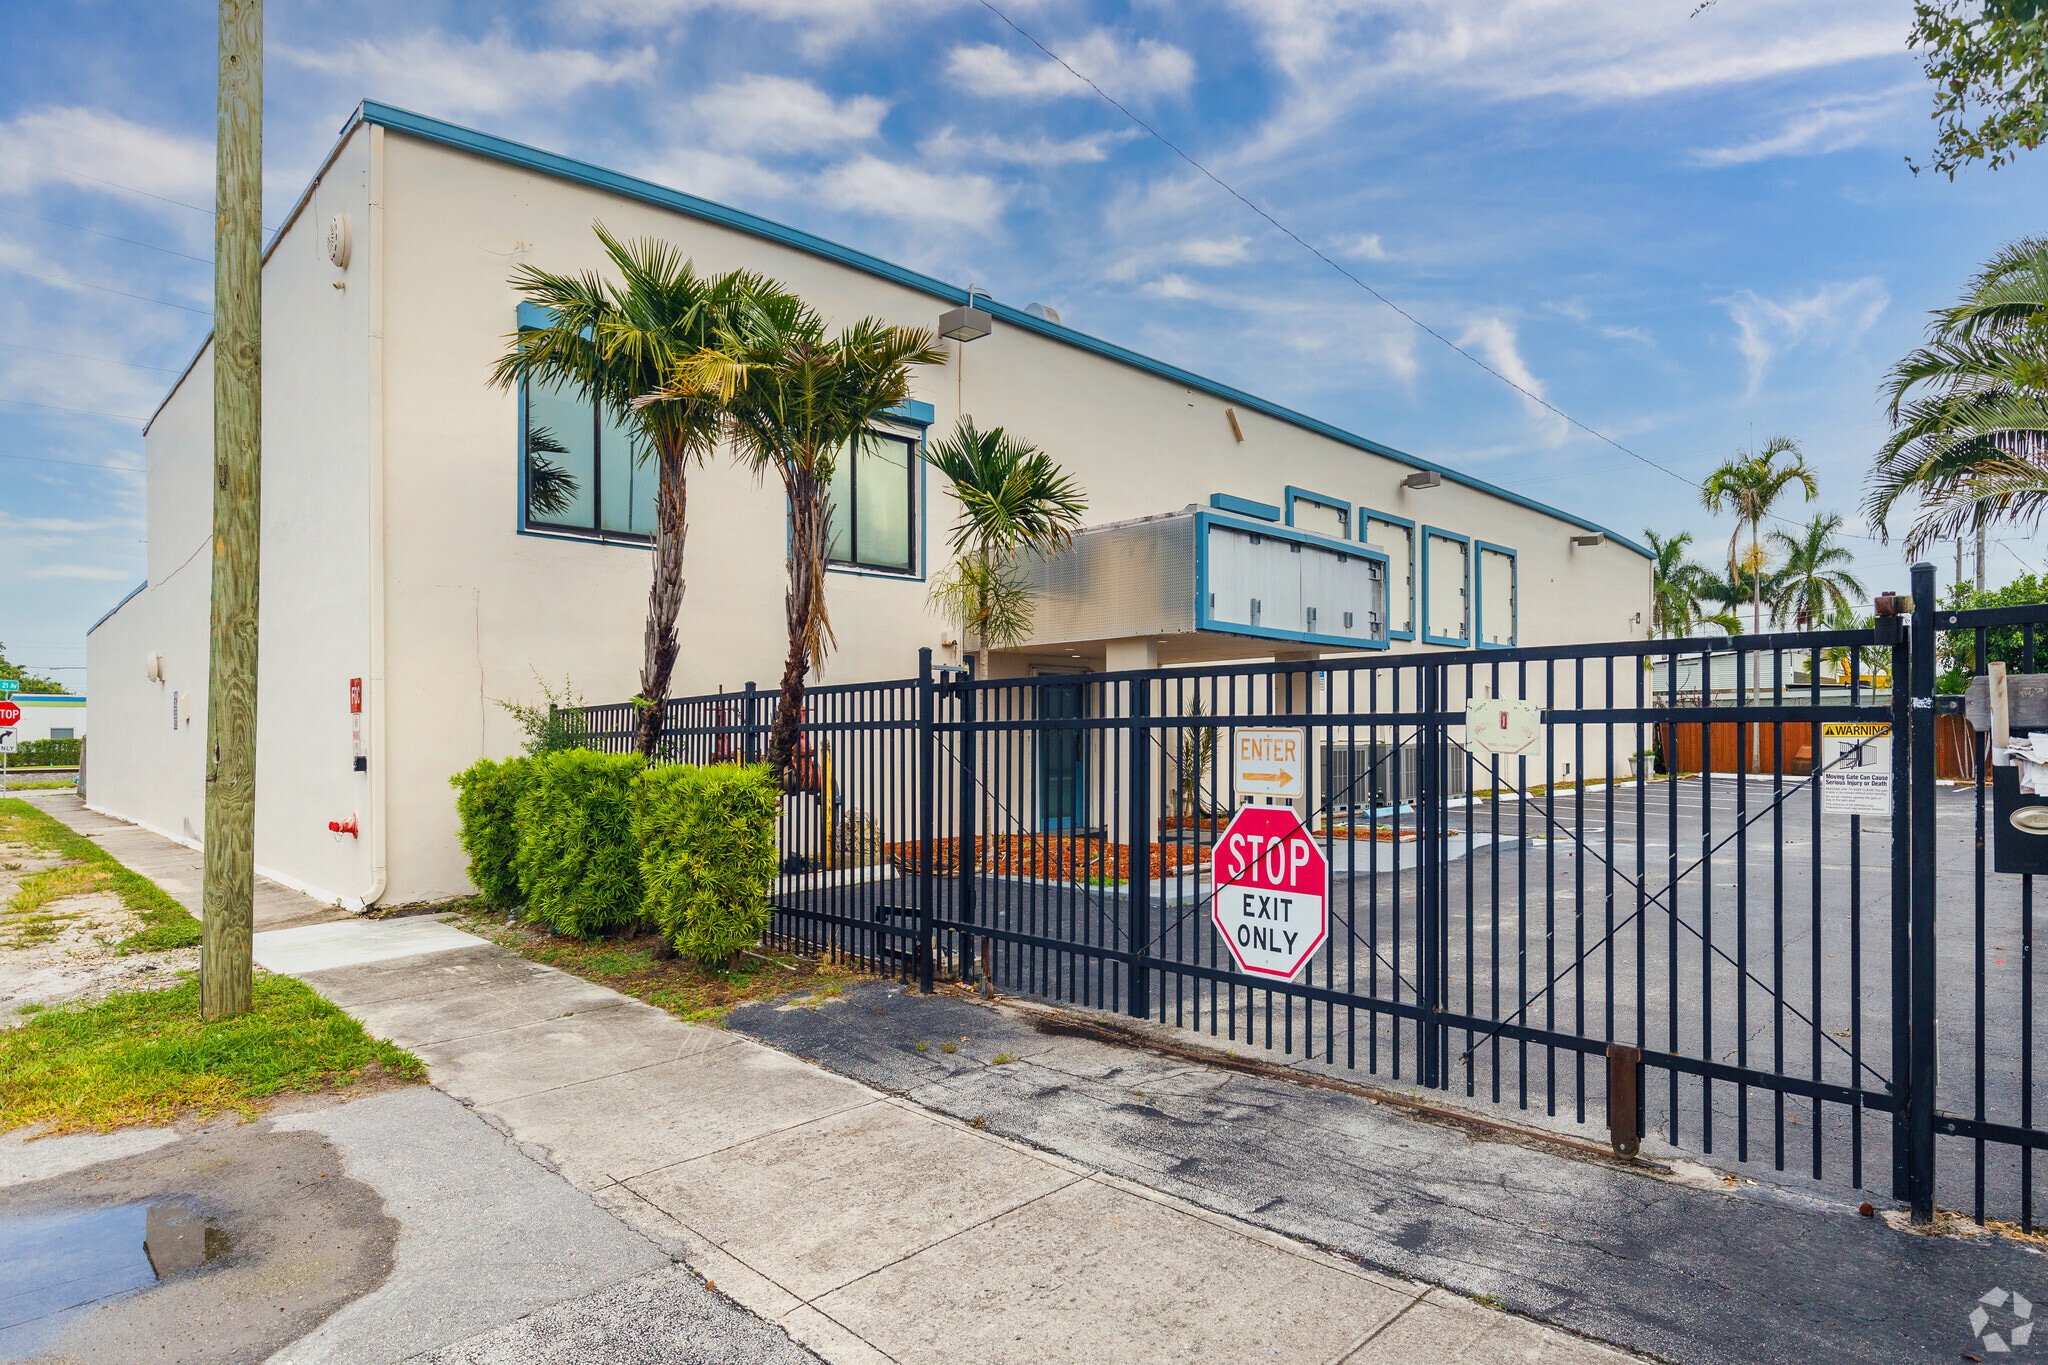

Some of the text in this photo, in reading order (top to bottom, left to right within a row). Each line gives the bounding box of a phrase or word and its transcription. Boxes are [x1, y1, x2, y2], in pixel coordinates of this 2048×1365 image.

[0, 709, 19, 719] TOP
[1835, 726, 1889, 735] WARNING
[1241, 738, 1296, 762] ENTER
[1228, 833, 1310, 886] STOP
[1243, 893, 1293, 922] EXIT
[1237, 923, 1299, 955] ONLY
